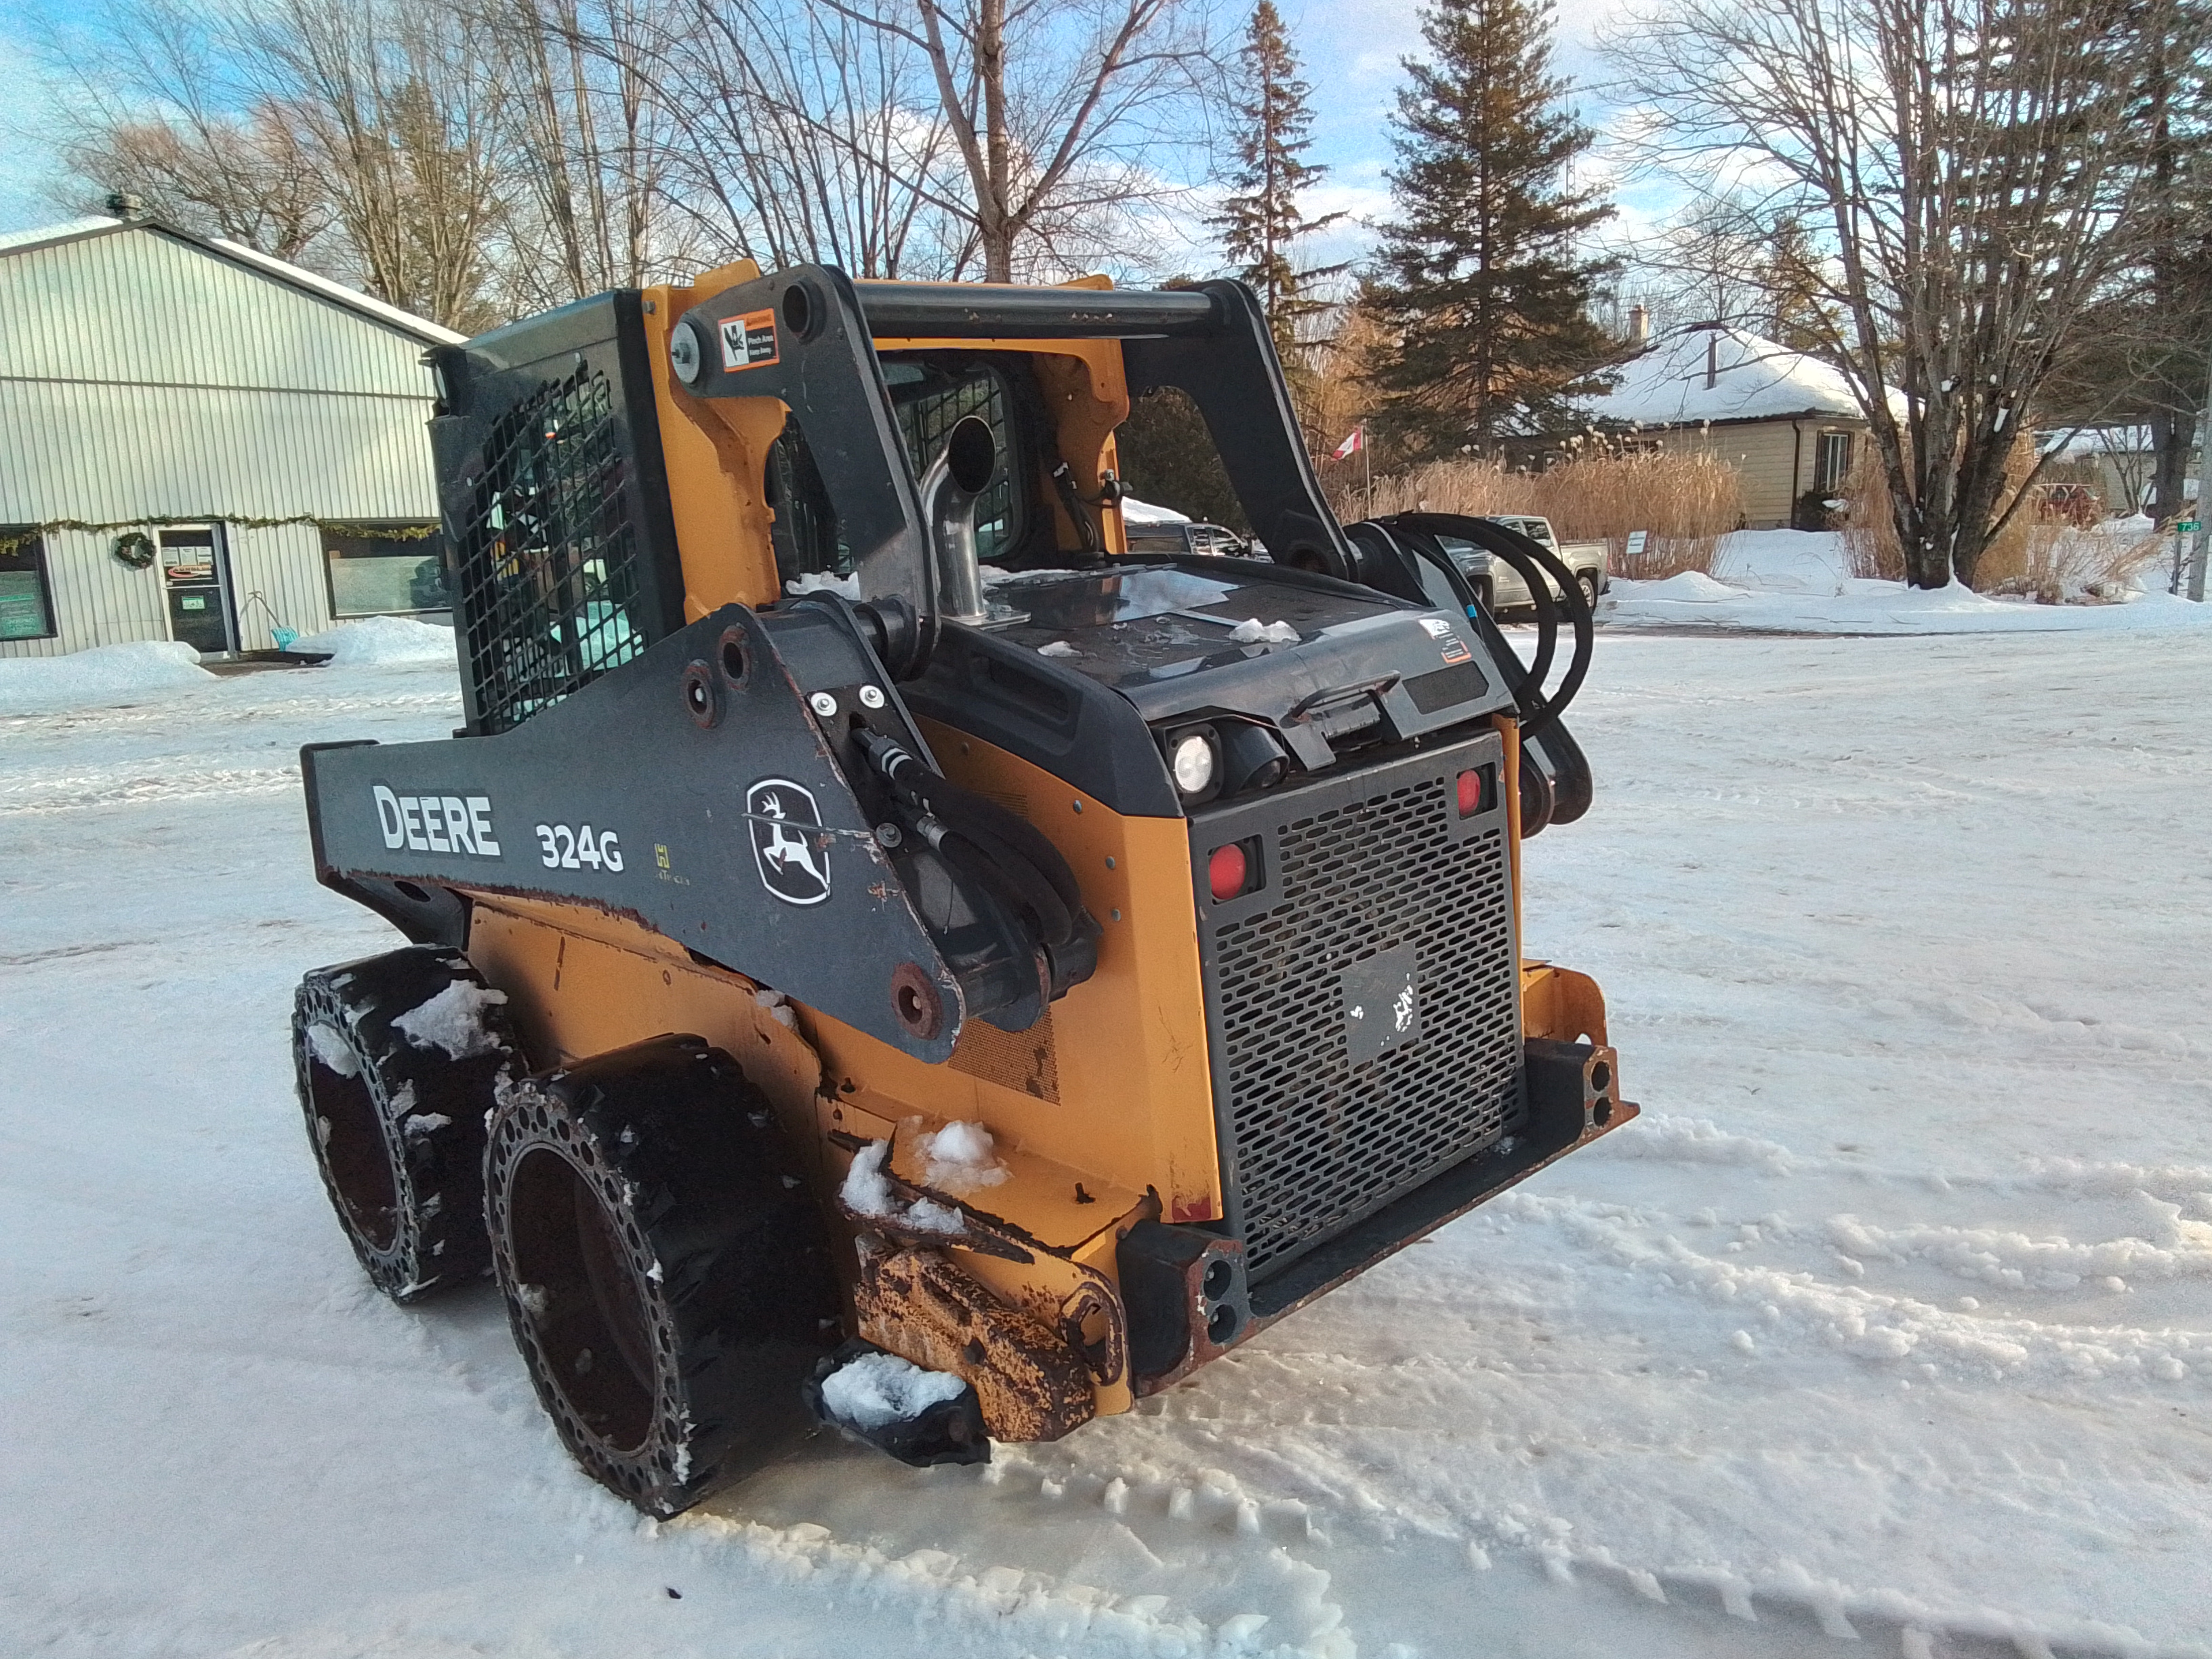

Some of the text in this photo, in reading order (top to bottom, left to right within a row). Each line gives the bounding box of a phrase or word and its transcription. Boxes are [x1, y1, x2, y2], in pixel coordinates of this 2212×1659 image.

[2182, 523, 2200, 531] 736
[373, 785, 501, 856] DEERE
[536, 824, 623, 872] 324G
